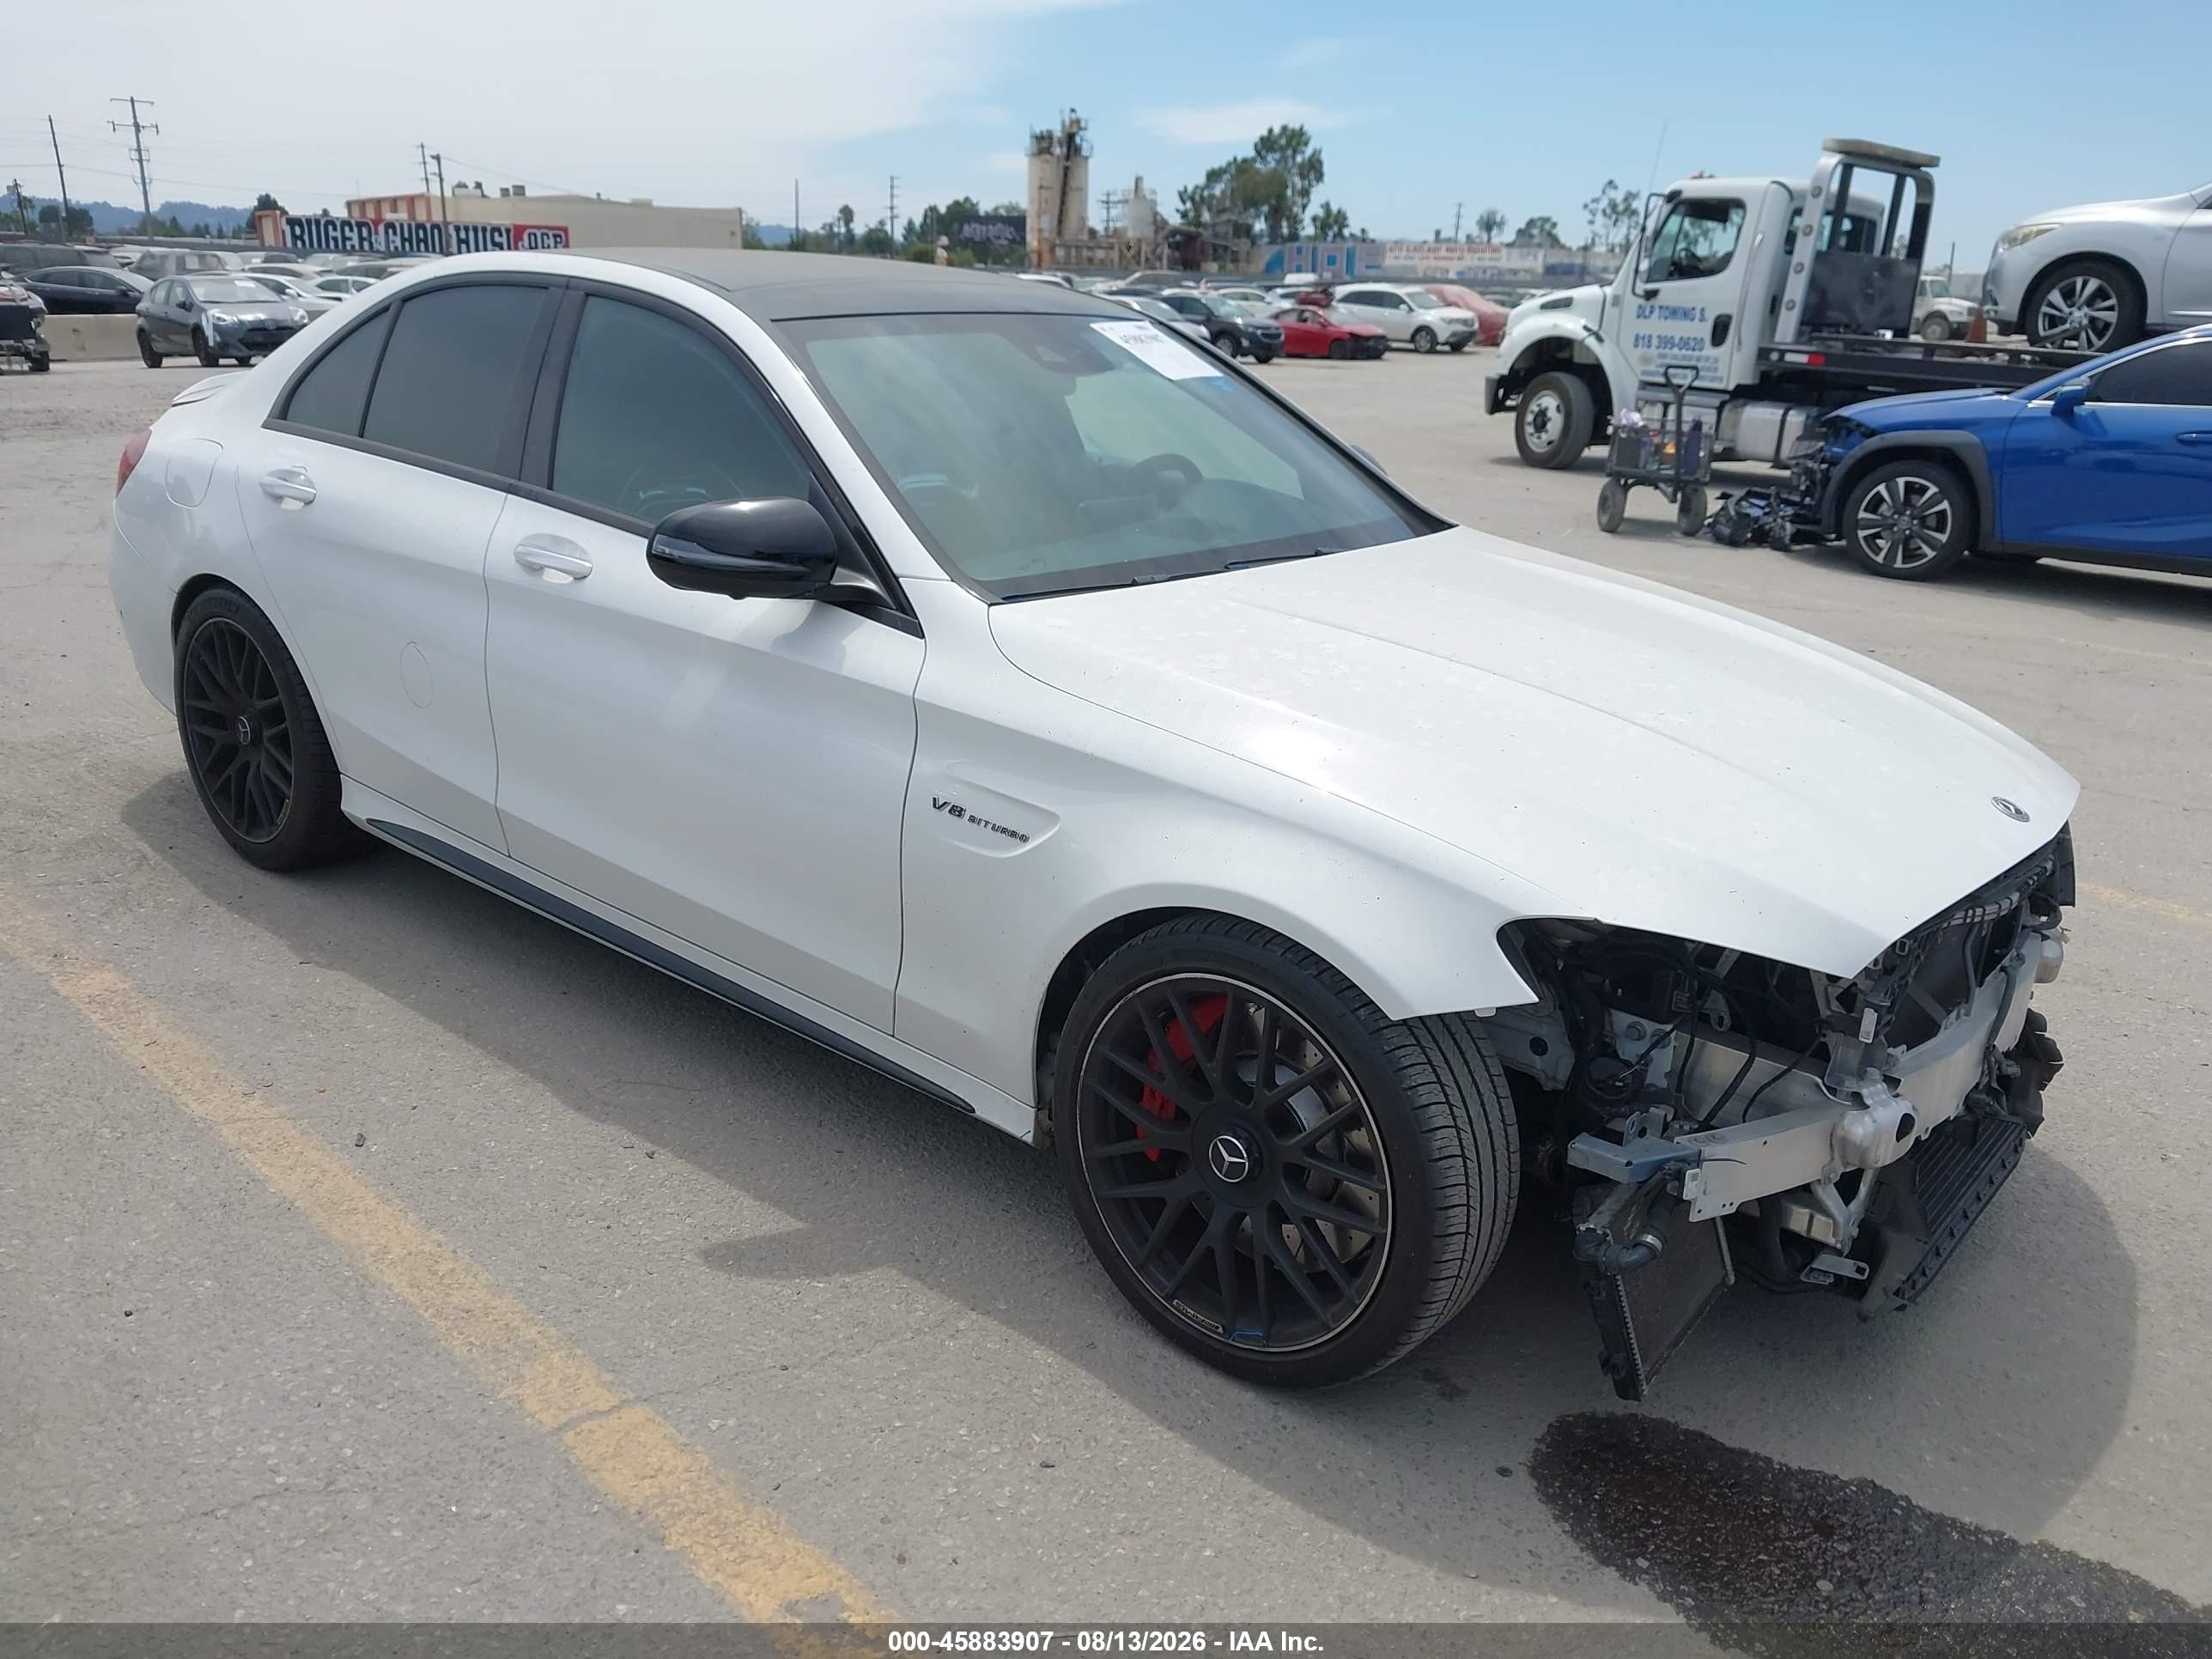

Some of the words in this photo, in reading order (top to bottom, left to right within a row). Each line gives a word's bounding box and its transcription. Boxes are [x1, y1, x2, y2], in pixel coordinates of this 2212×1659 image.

[1658, 305, 1697, 322] TOWING
[1633, 332, 1653, 349] 818
[932, 795, 966, 819] V8
[967, 814, 1030, 843] BITURBO
